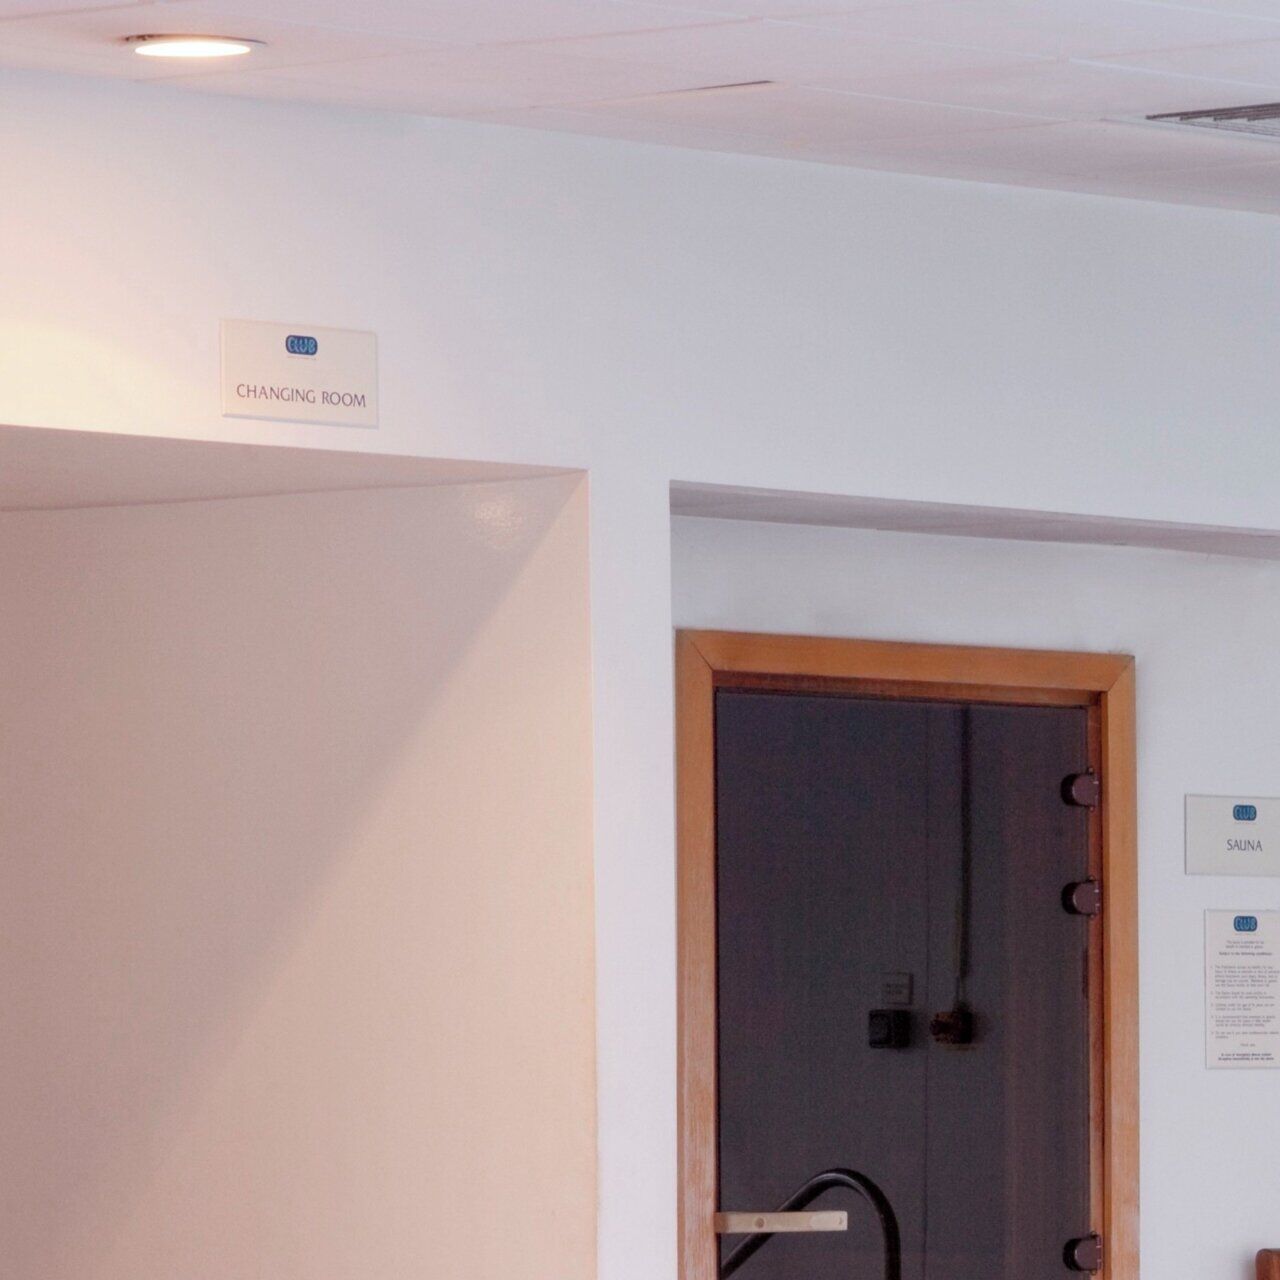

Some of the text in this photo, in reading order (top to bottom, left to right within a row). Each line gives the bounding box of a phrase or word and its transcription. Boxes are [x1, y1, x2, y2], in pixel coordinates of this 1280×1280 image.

[287, 336, 317, 354] CLUB
[236, 383, 367, 408] CHANGING ROOM
[1234, 805, 1256, 820] CLUB
[1226, 838, 1263, 851] SAUNA
